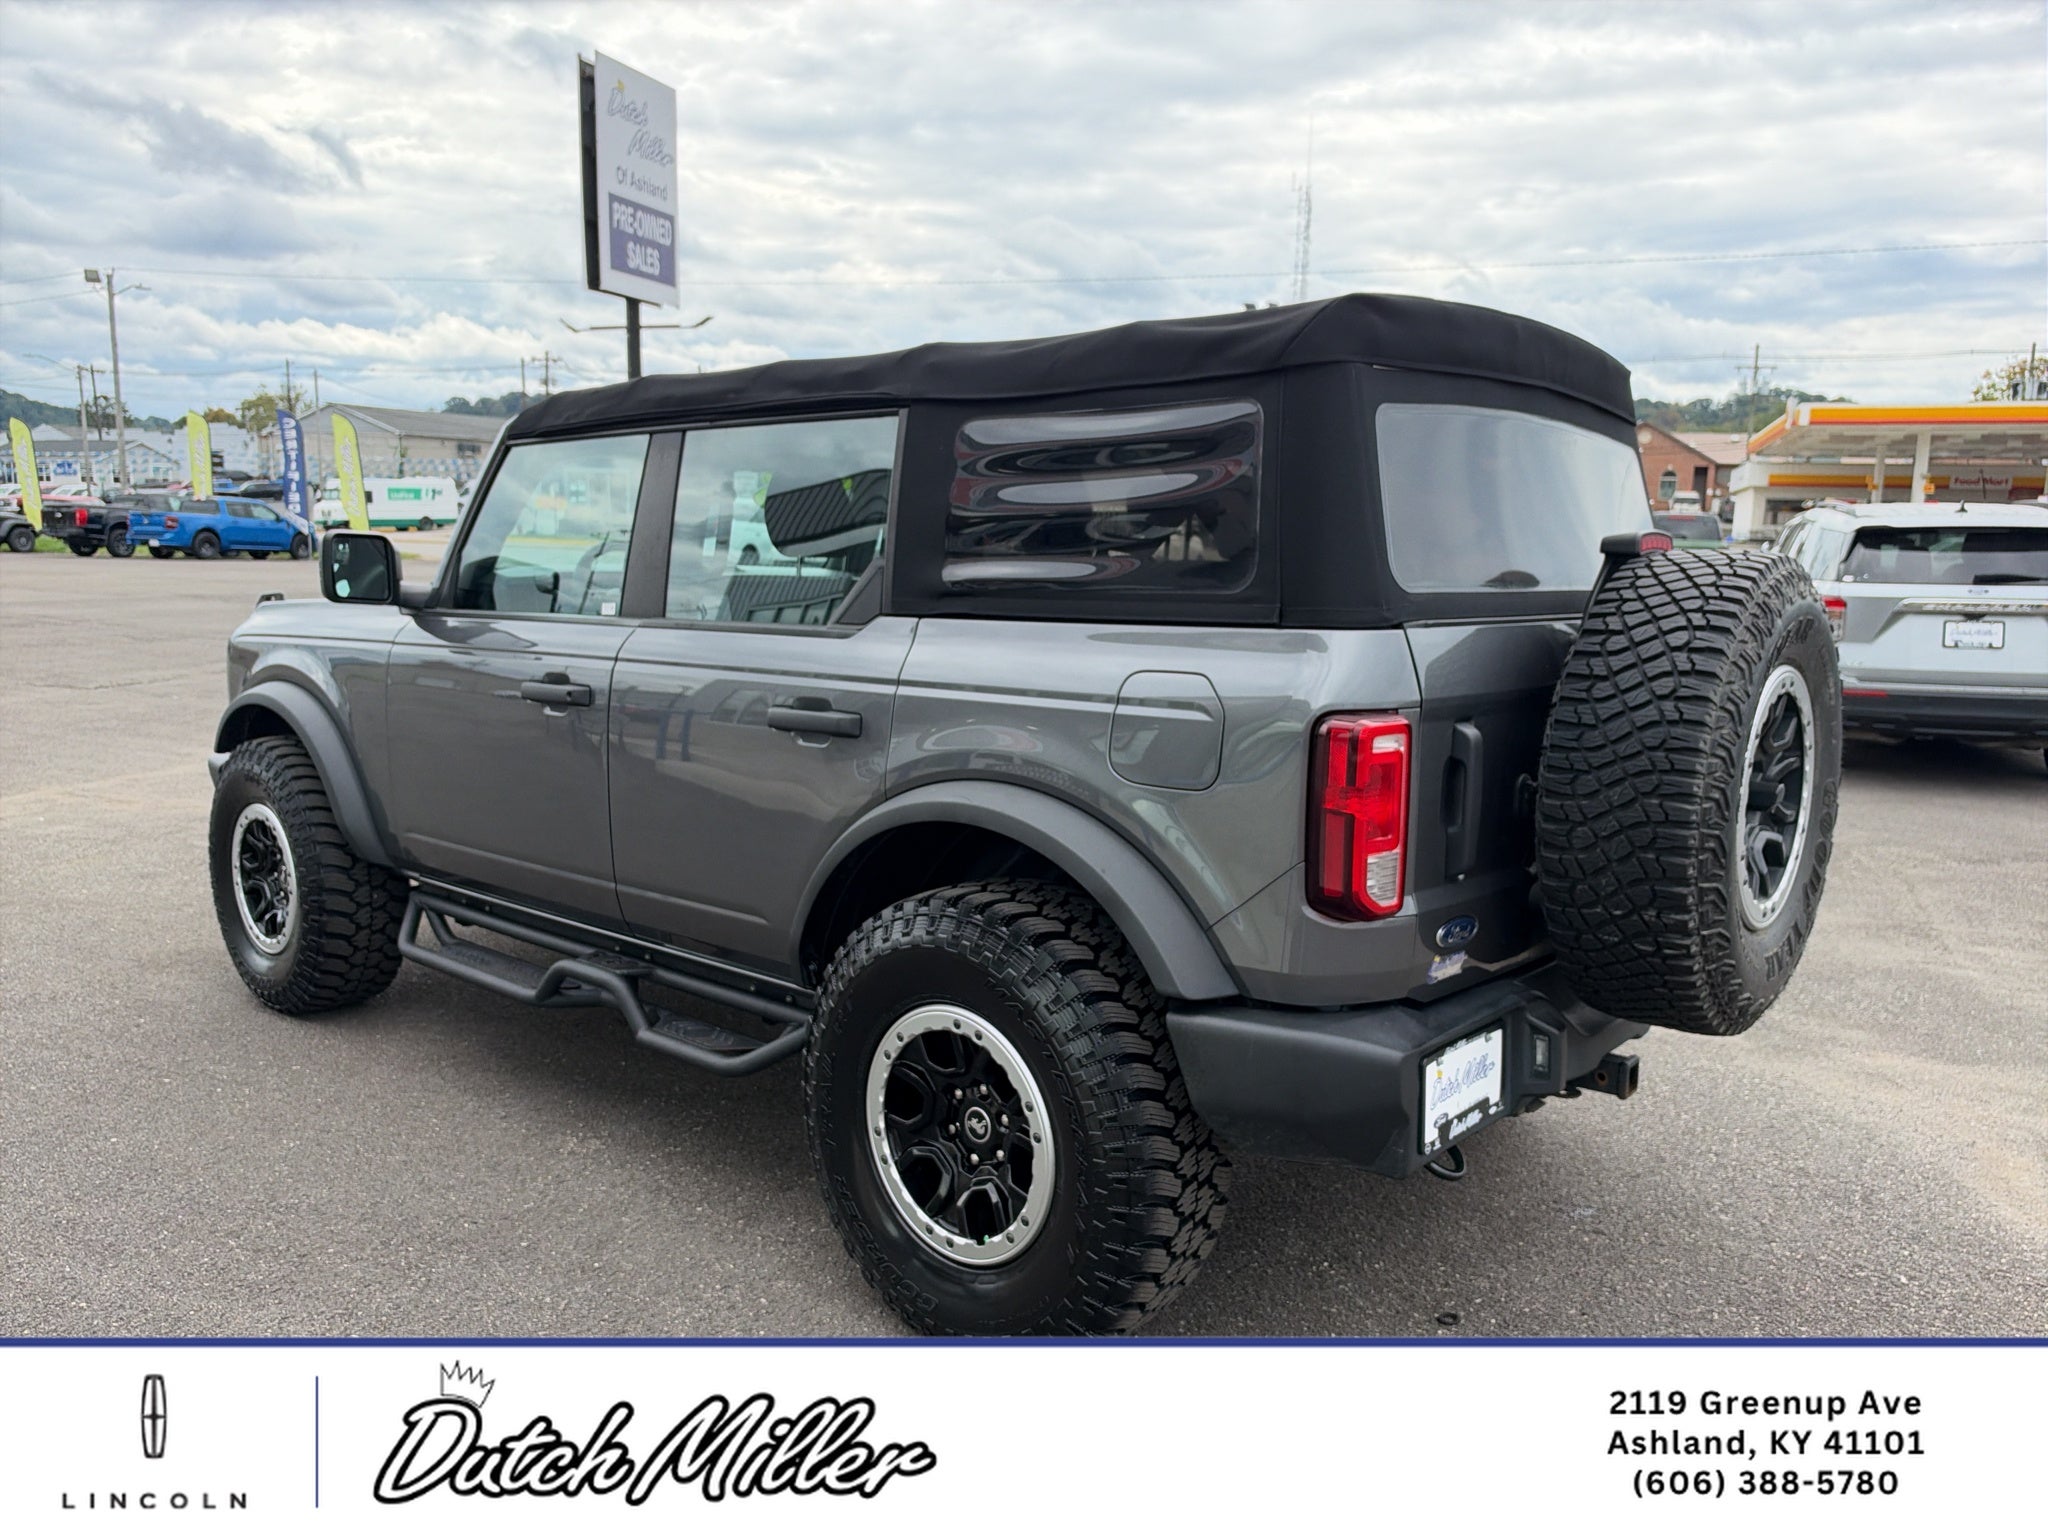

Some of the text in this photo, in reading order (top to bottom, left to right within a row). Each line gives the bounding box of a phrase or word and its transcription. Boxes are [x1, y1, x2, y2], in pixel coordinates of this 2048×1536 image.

[607, 88, 648, 127] Dutch
[627, 128, 674, 167] Miller
[630, 171, 668, 201] Ashland
[612, 201, 672, 247] PRE-OWNED
[626, 241, 660, 276] SALES
[1430, 1053, 1495, 1110] Dutch Miller
